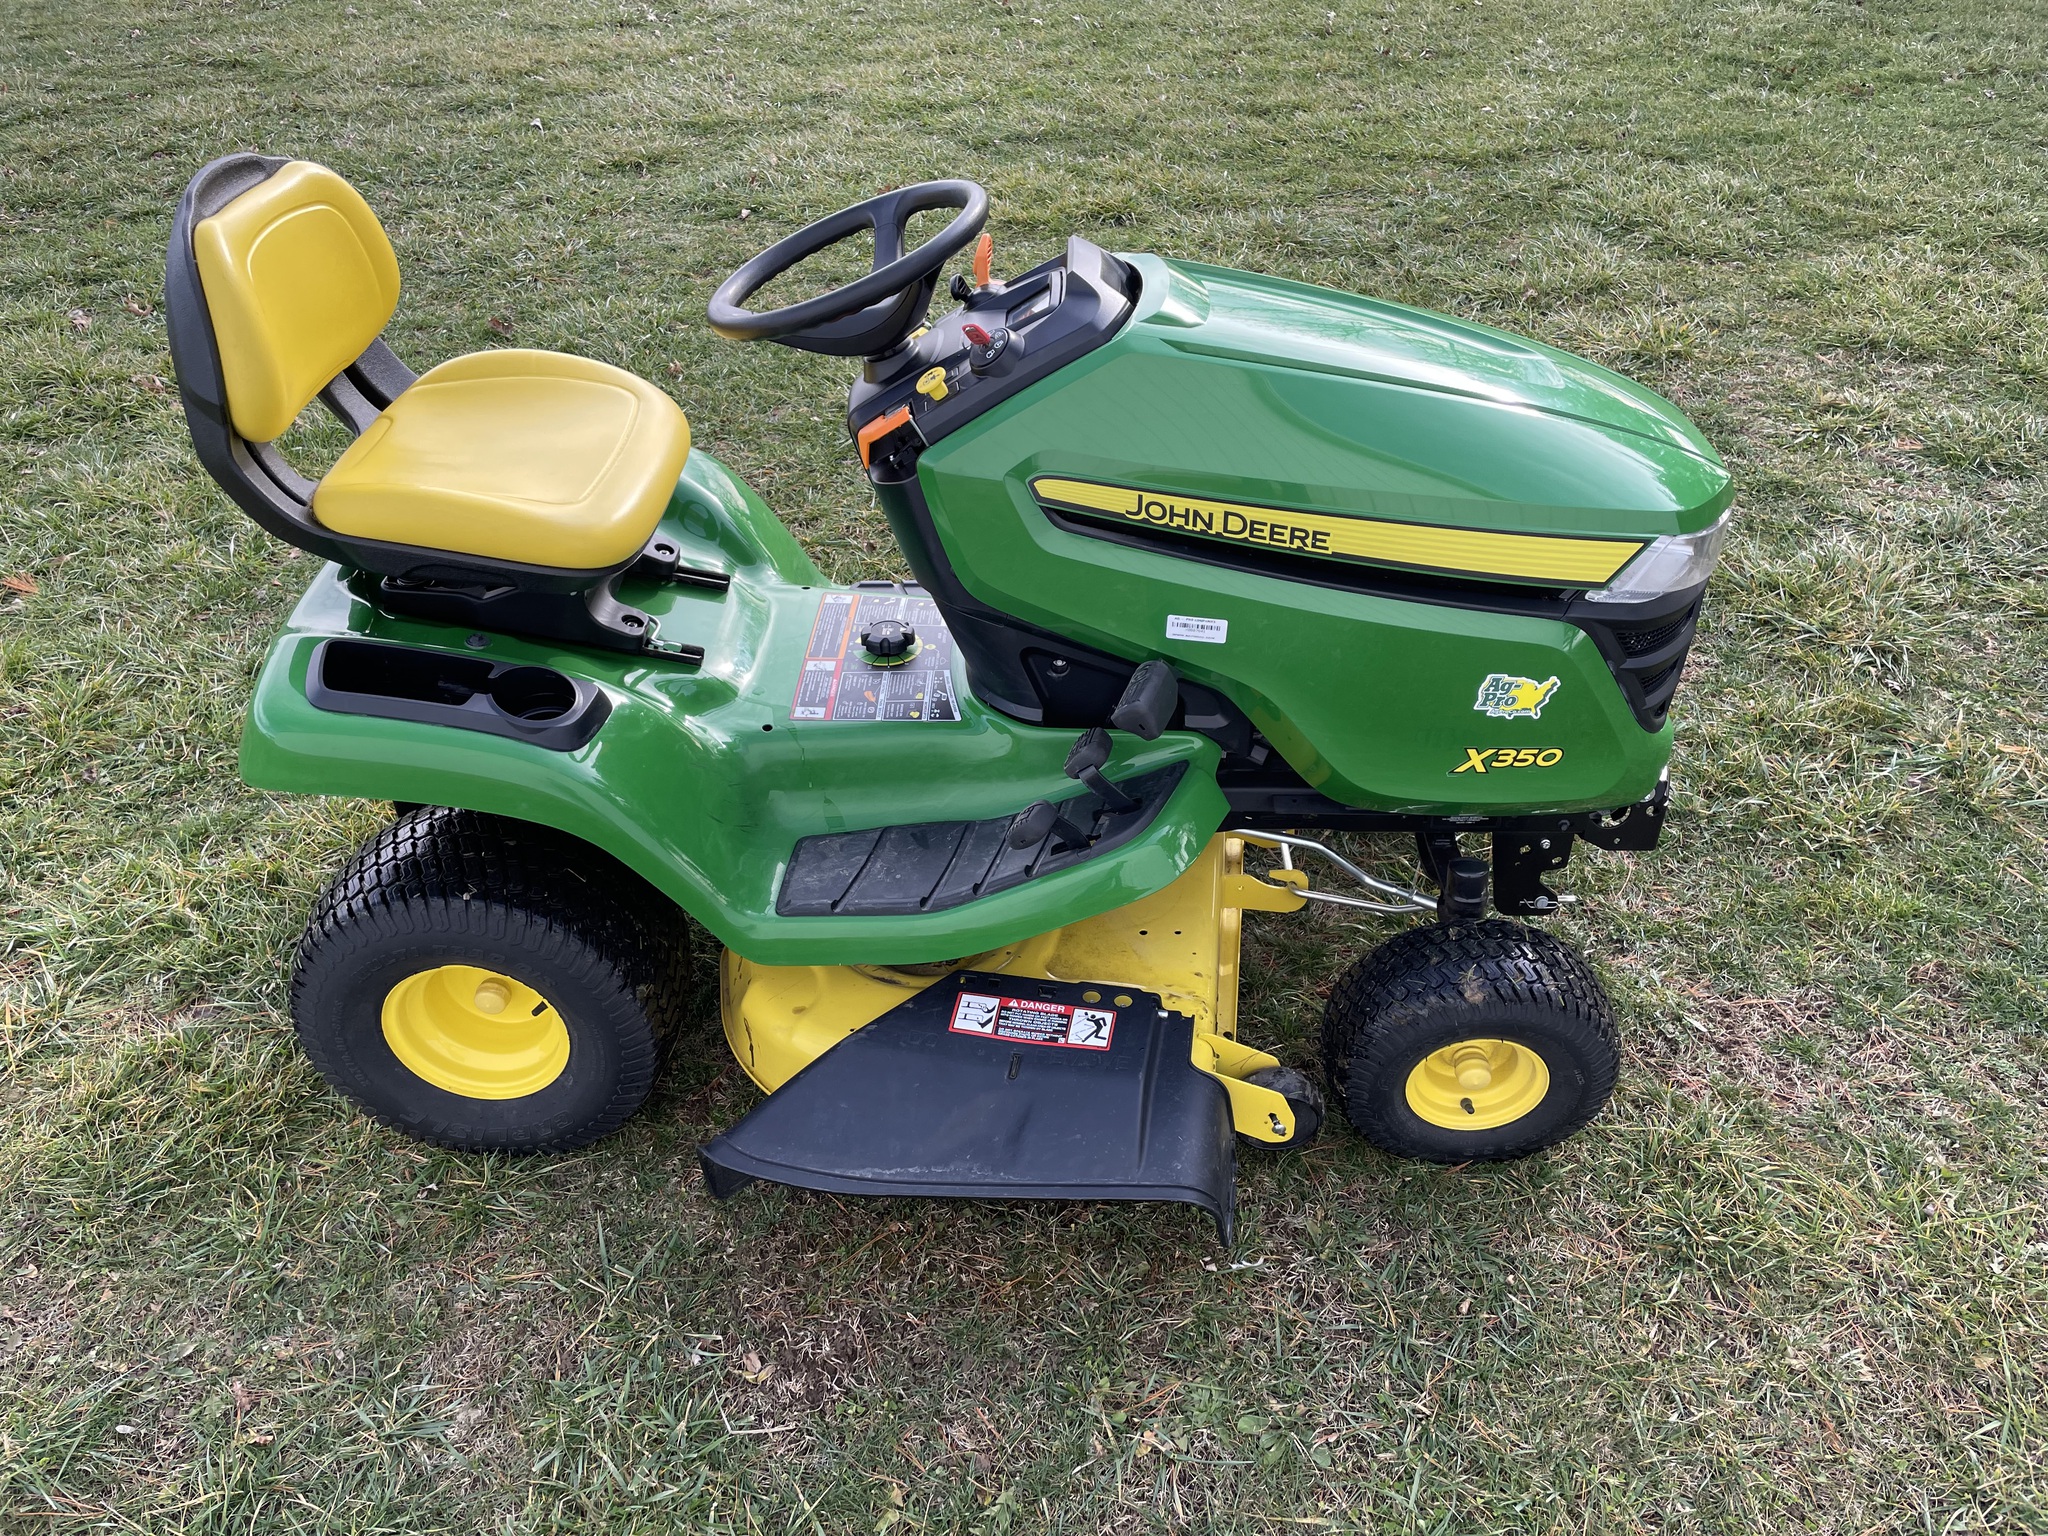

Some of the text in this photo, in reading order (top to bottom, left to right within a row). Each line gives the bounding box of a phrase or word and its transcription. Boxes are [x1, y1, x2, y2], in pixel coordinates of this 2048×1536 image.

[1125, 494, 1331, 551] JOHN DEERE
[1479, 692, 1517, 708] Pro
[1450, 747, 1564, 774] X350
[1020, 1000, 1065, 1013] DANGER
